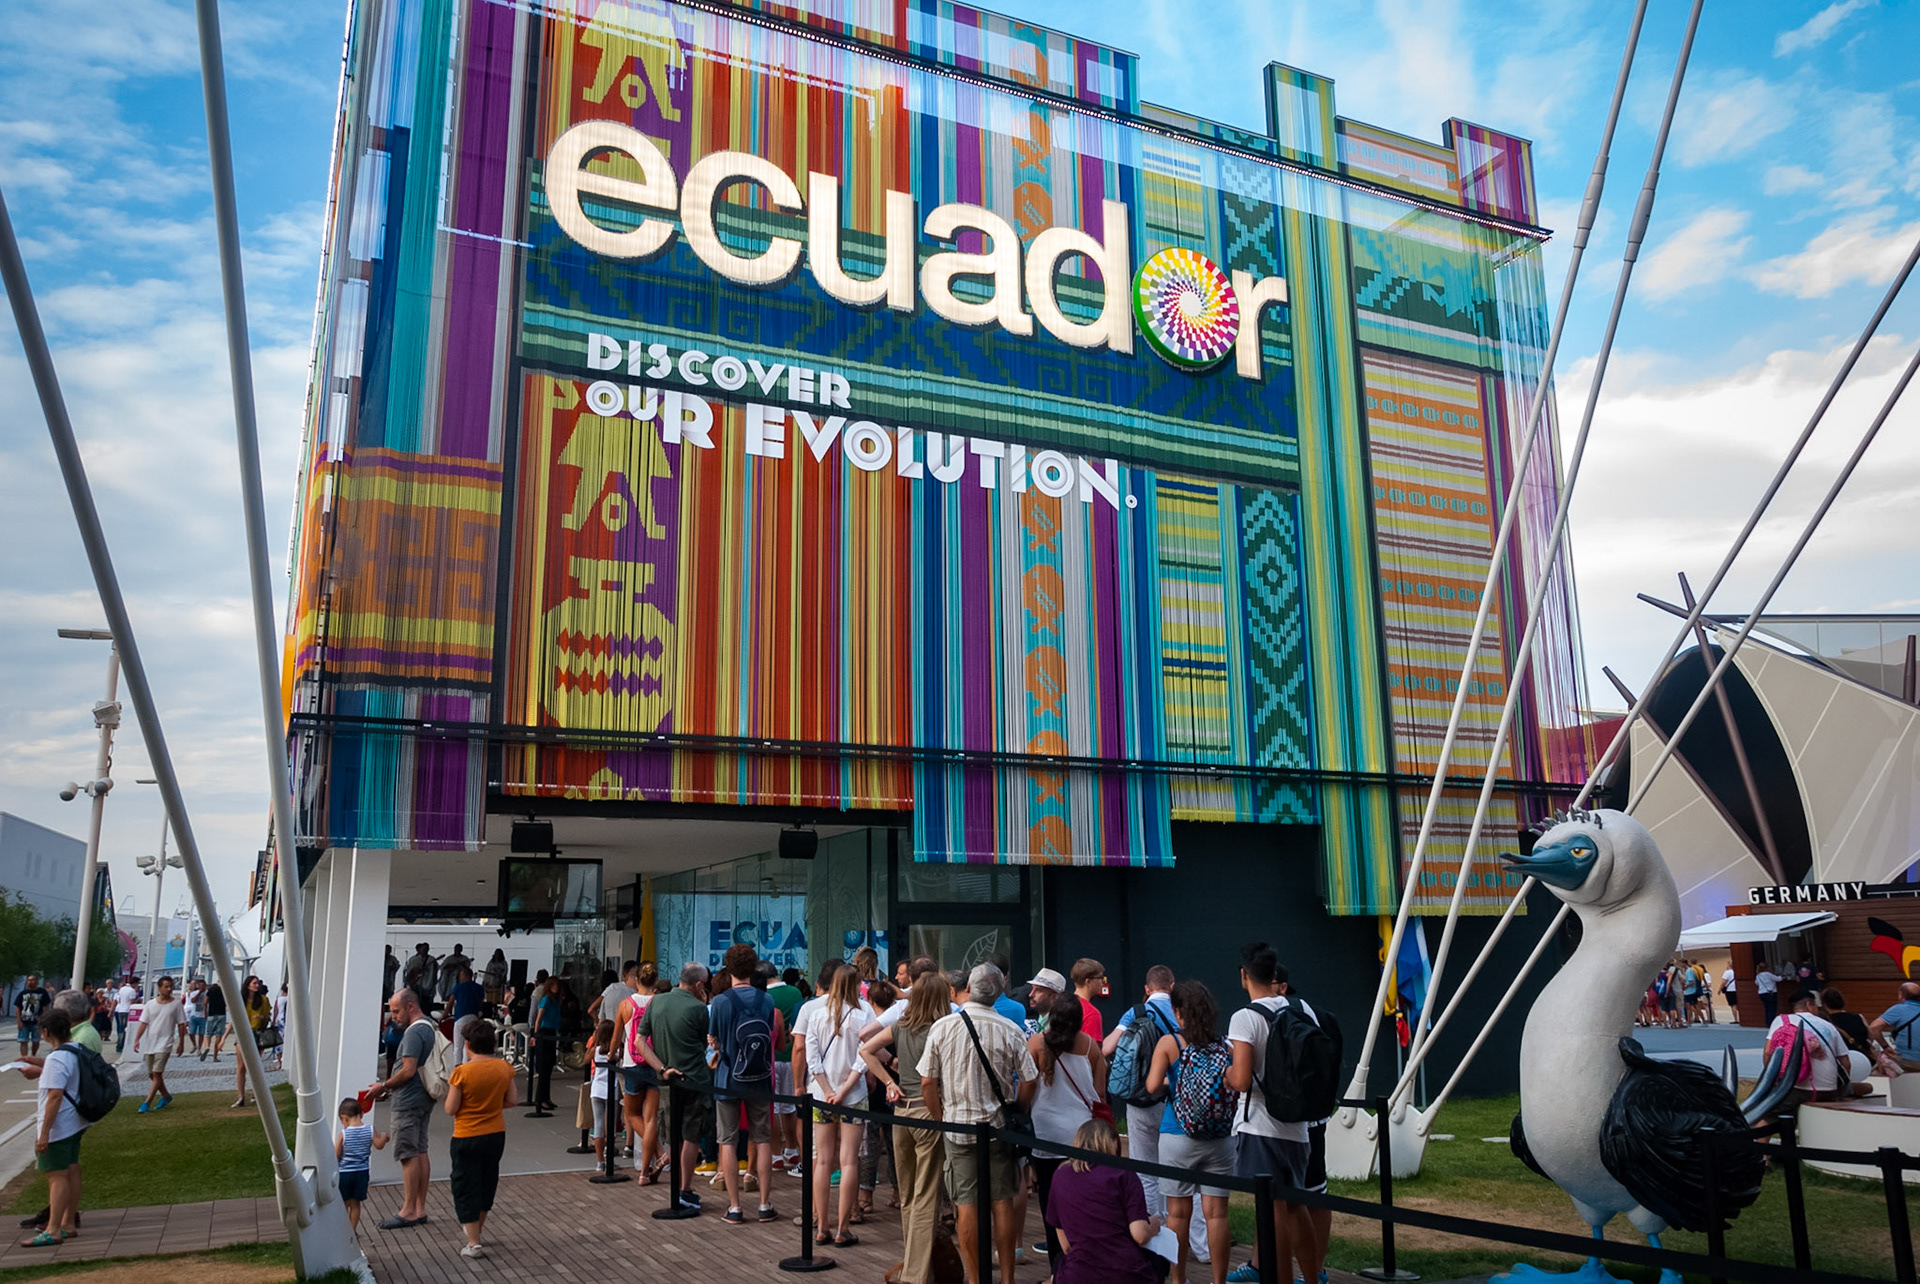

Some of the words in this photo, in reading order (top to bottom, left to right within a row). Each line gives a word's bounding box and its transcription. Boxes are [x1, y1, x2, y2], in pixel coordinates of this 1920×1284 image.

[544, 119, 1288, 380] ecuador
[587, 332, 852, 409] DISCOVER
[586, 380, 716, 449] OUR
[745, 402, 1138, 511] EVOLUTION.
[1748, 882, 1863, 905] GERMANY
